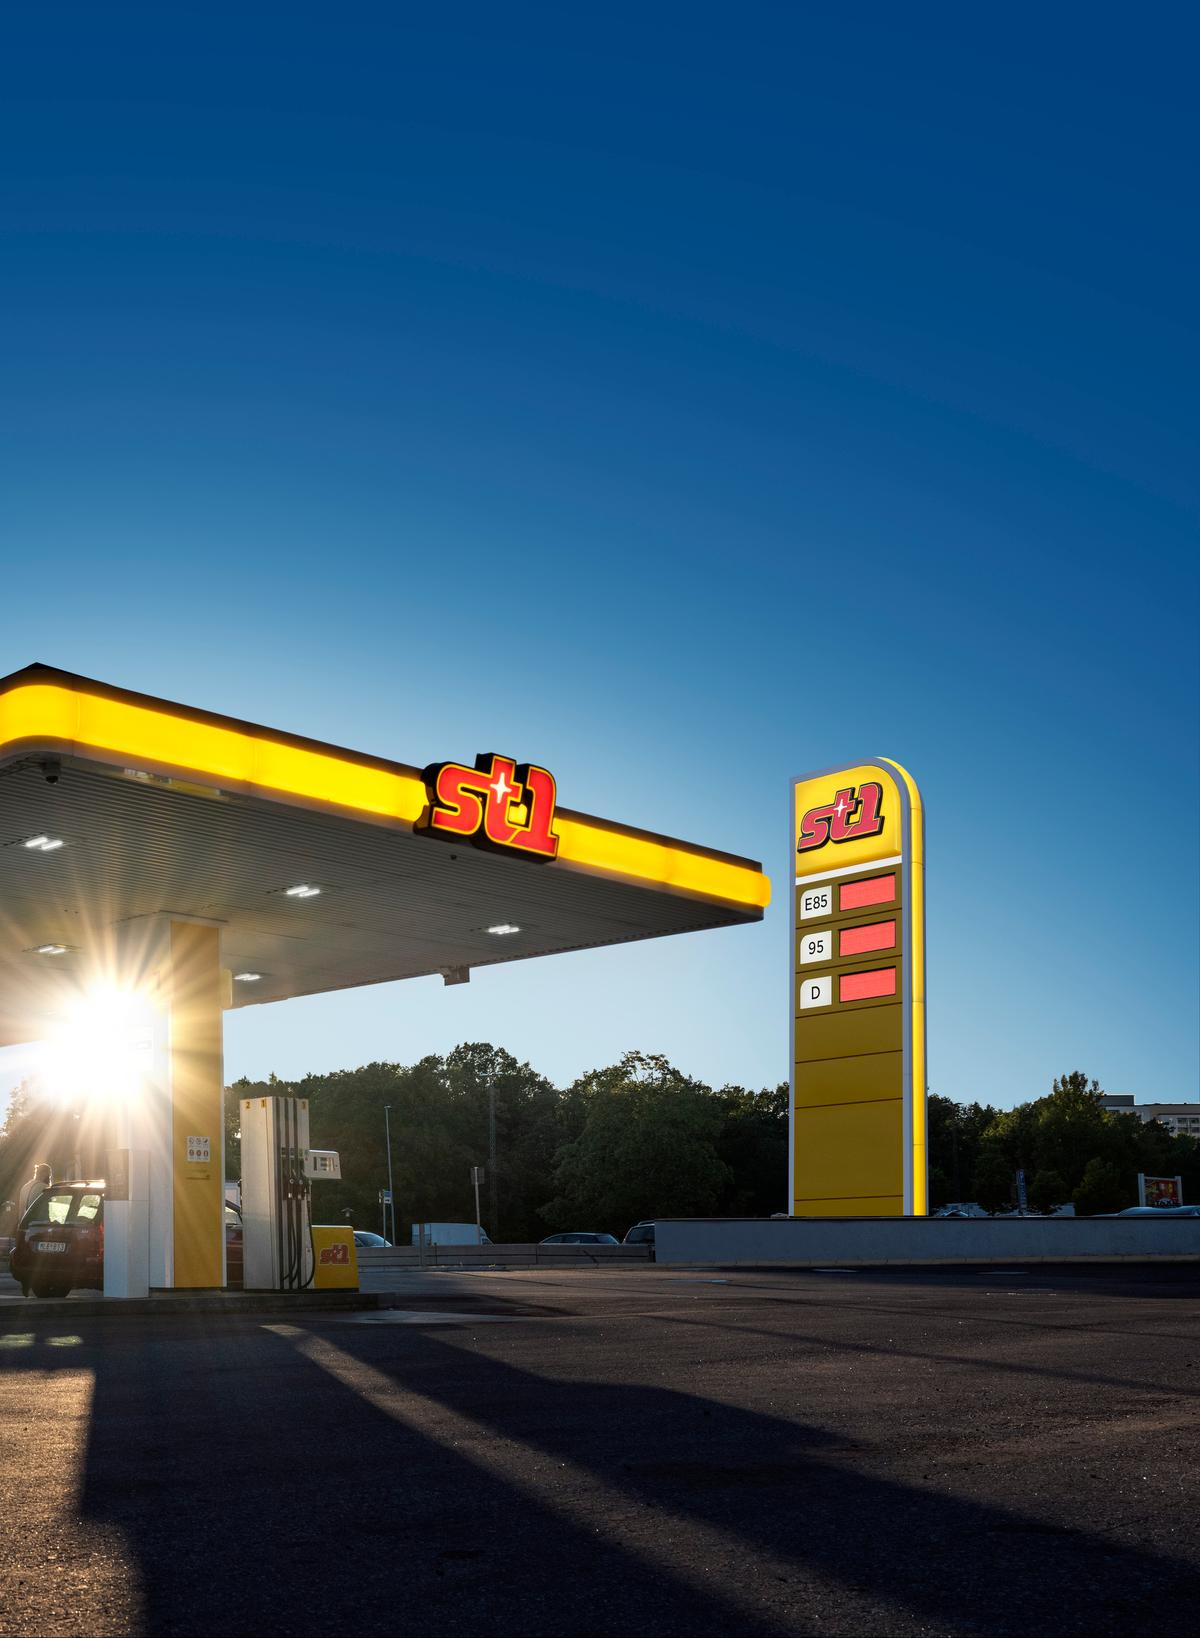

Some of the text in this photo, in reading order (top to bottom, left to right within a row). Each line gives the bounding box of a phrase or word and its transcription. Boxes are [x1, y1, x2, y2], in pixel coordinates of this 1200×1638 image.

[430, 754, 560, 859] st1
[797, 781, 886, 853] st1
[804, 894, 828, 911] E85
[808, 940, 824, 955] 95
[810, 985, 821, 1000] D
